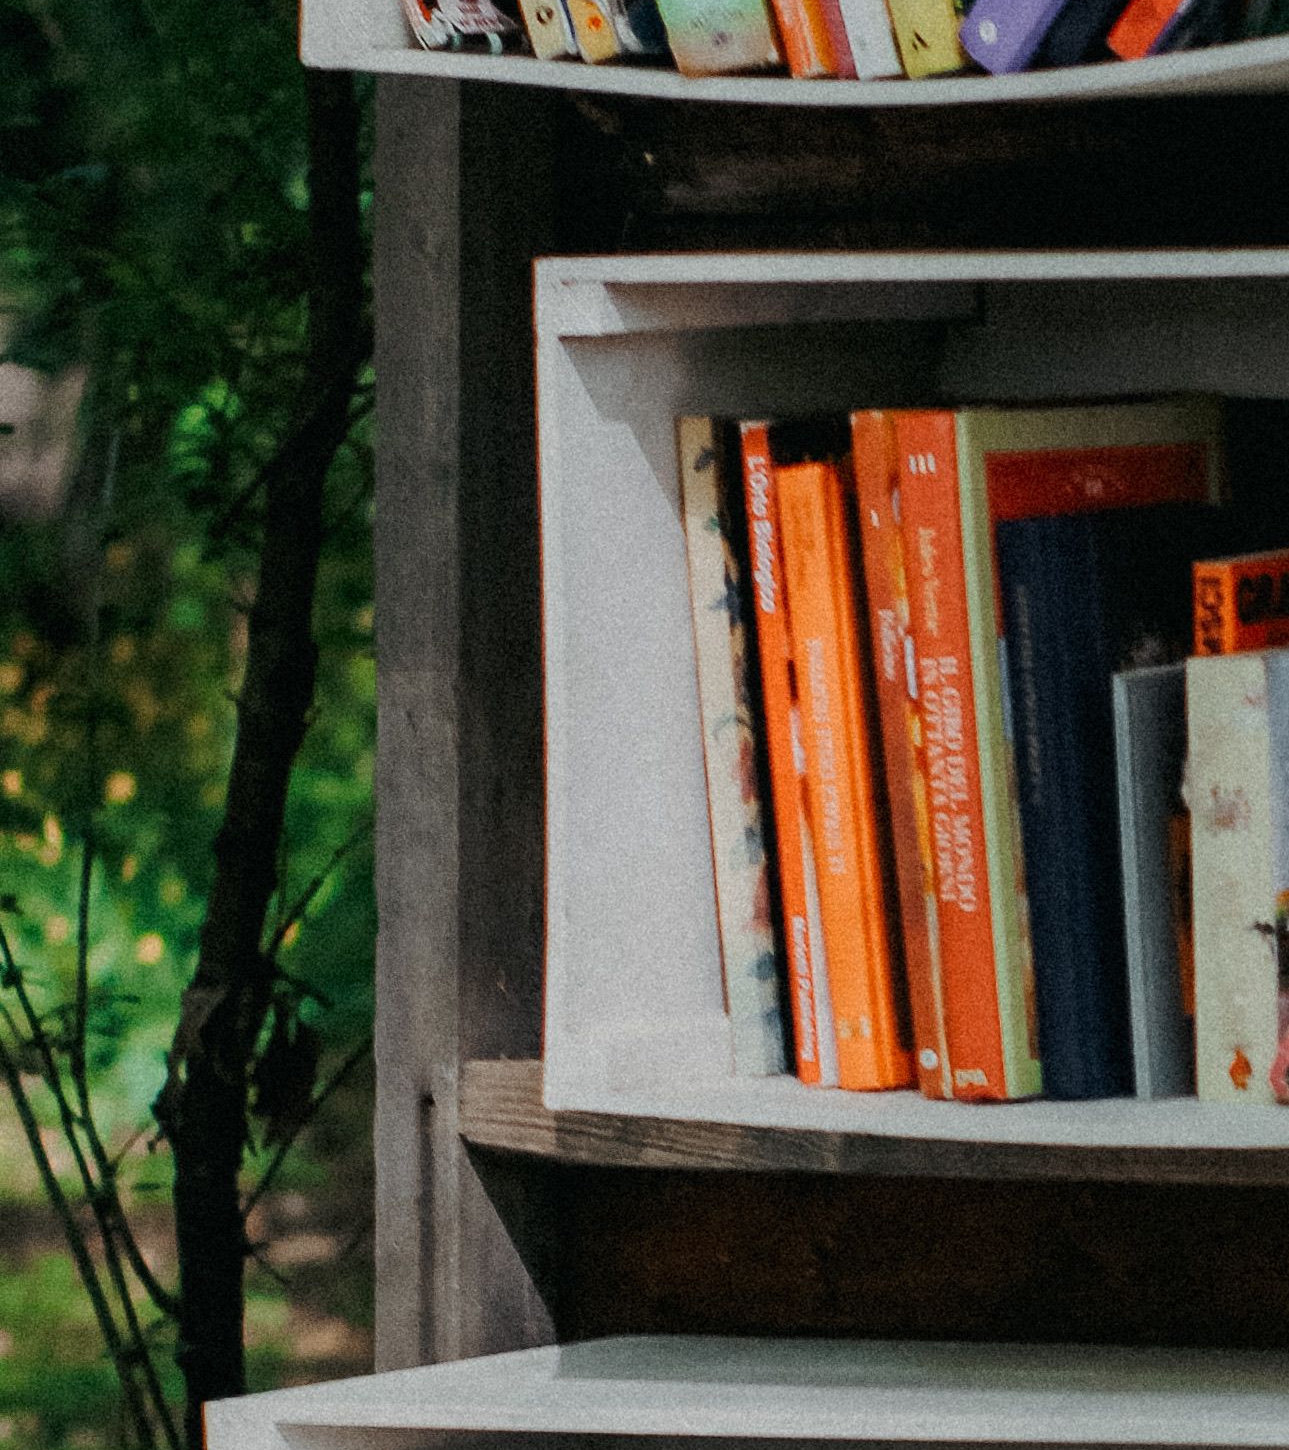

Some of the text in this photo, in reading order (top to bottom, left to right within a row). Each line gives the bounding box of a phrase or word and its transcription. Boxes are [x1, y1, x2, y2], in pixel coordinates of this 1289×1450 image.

[746, 454, 782, 614] L'Orto Biologico
[920, 689, 950, 807] OTTANTA
[936, 655, 978, 913] IL GIRO DEL MONDO
